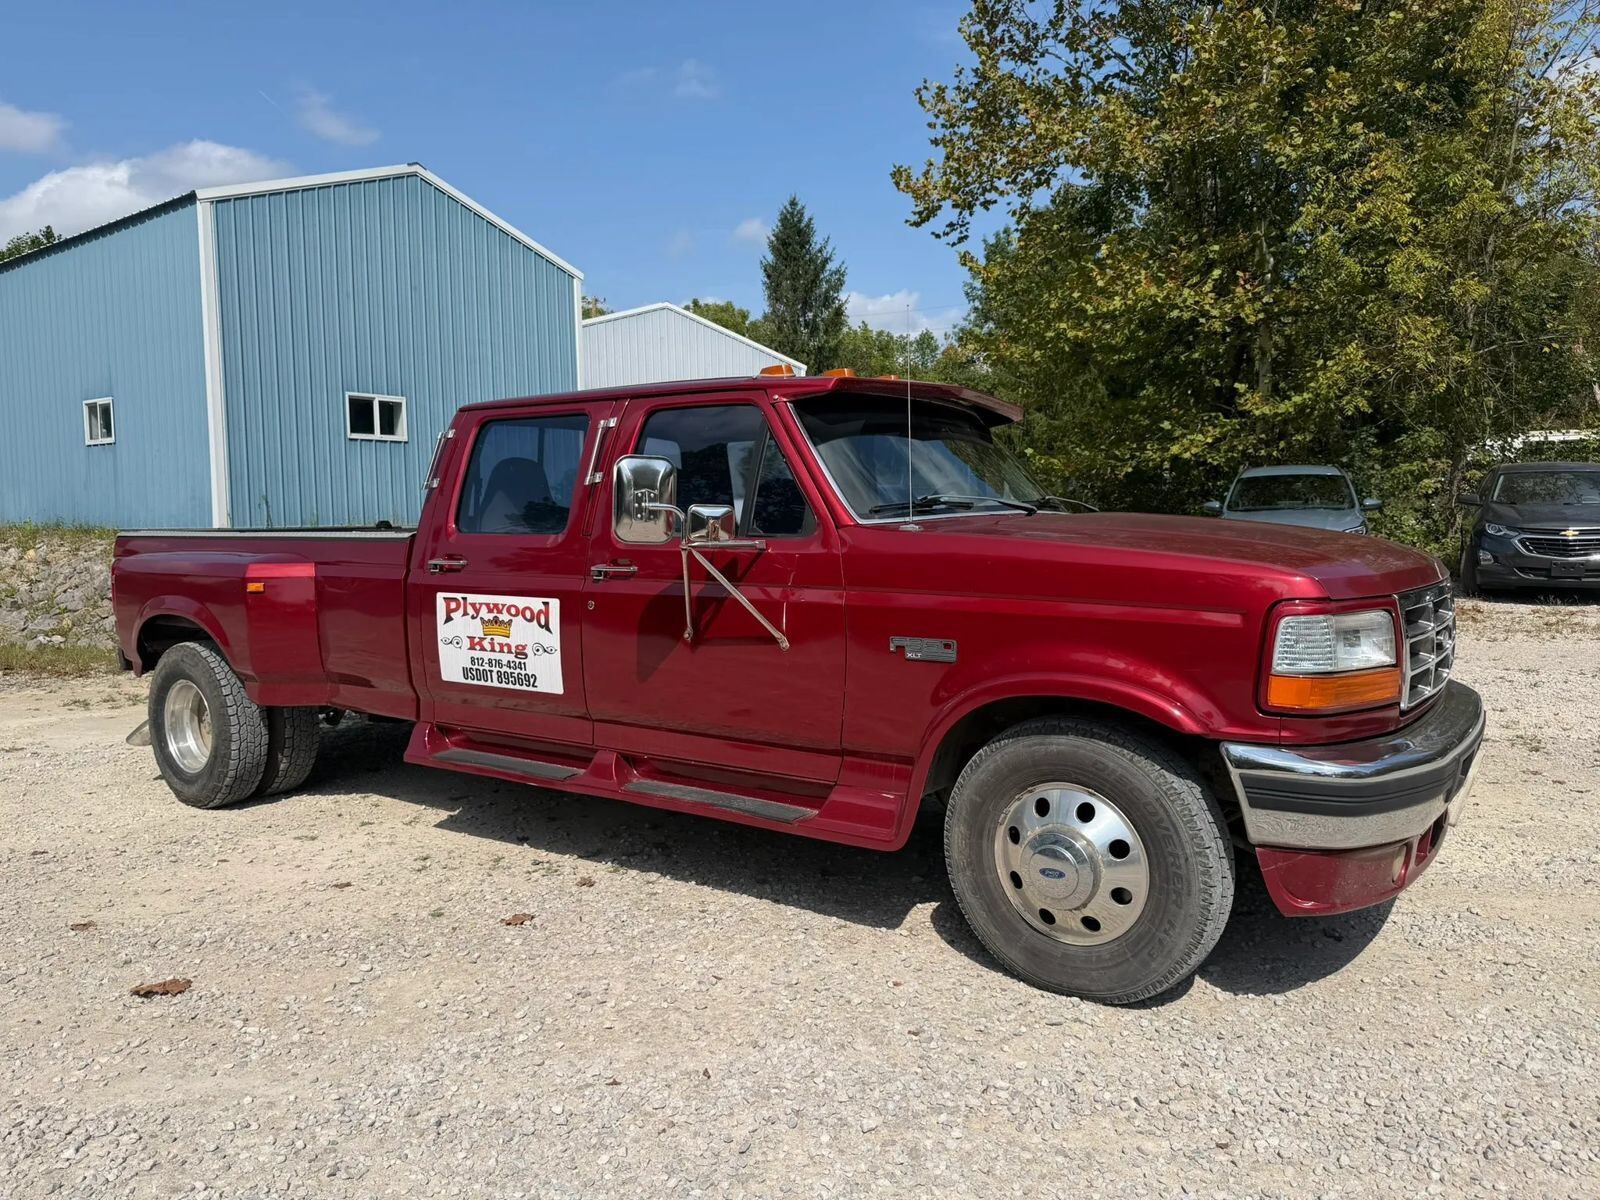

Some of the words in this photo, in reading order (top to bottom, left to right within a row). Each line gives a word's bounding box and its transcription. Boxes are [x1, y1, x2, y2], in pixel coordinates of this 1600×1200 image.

[442, 596, 553, 635] Plywood
[466, 635, 529, 660] King
[470, 656, 527, 671] 812-876-4341
[462, 666, 494, 683] USDOT
[496, 671, 538, 688] 895692
